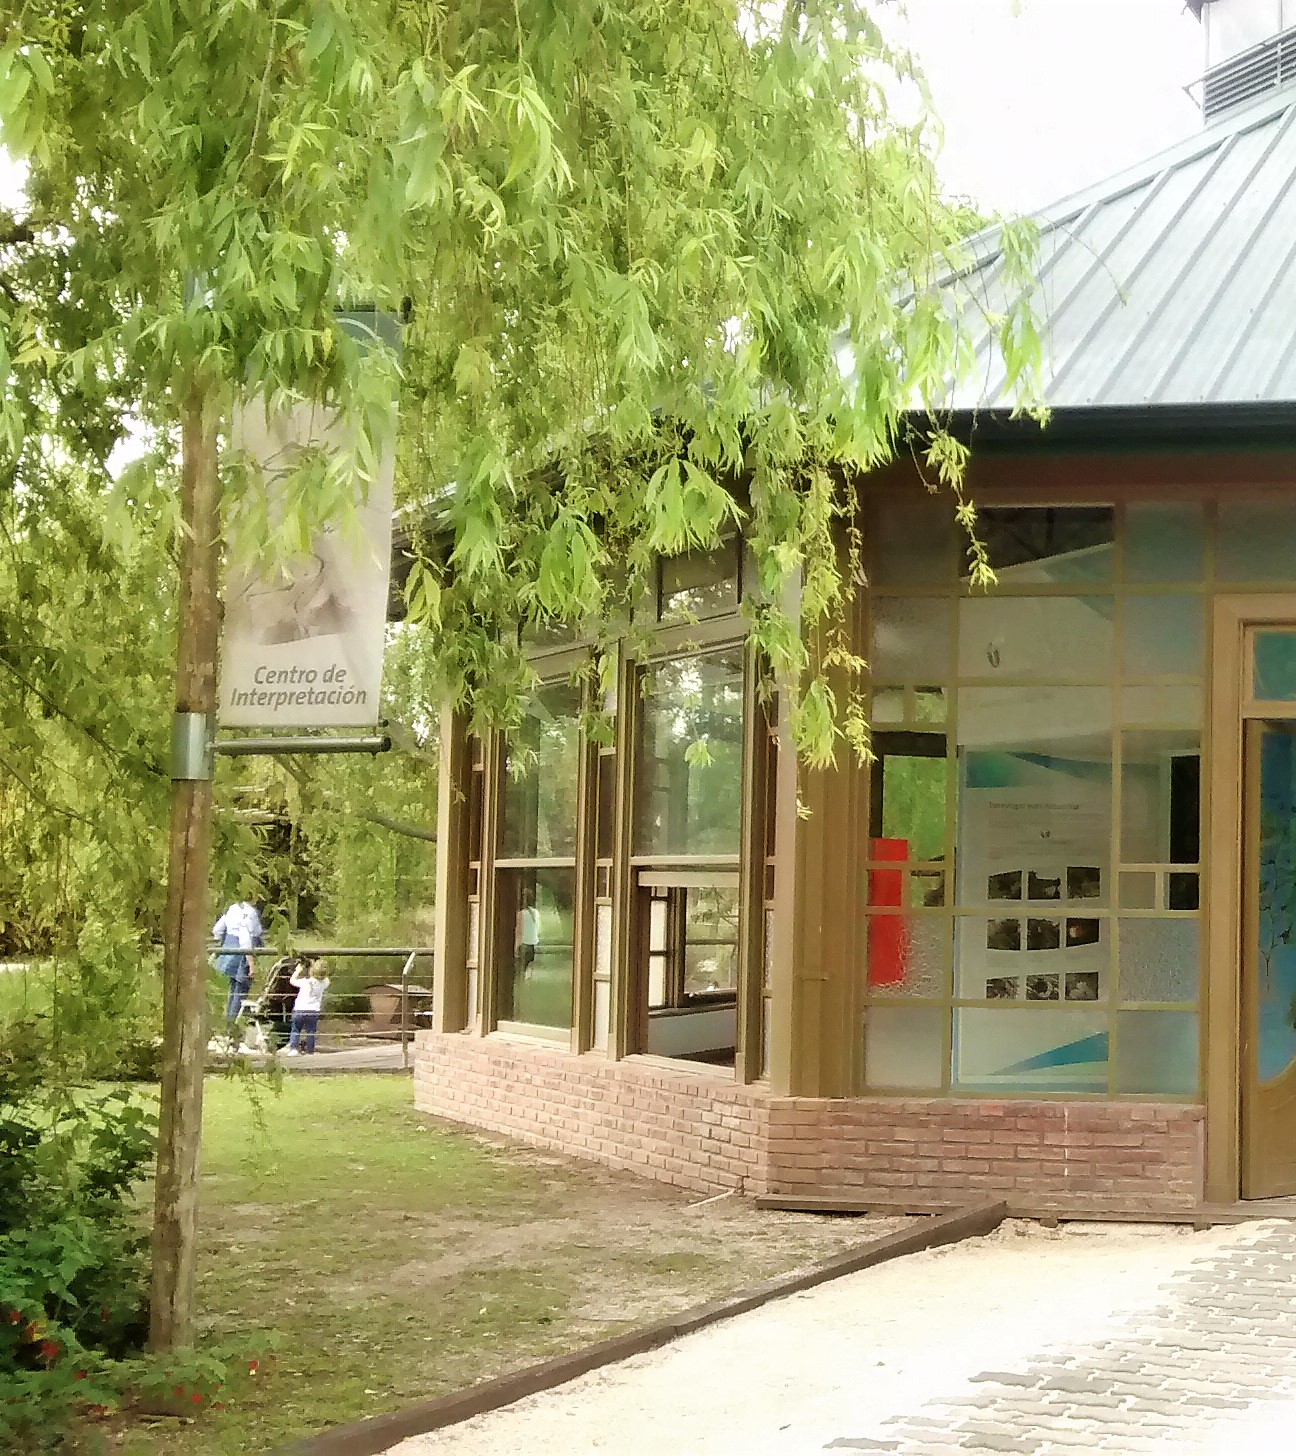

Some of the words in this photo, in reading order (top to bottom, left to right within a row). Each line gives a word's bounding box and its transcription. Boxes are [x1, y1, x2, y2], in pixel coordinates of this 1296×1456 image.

[254, 665, 318, 685] Centro
[322, 663, 347, 683] de
[230, 684, 367, 712] Interpretación
